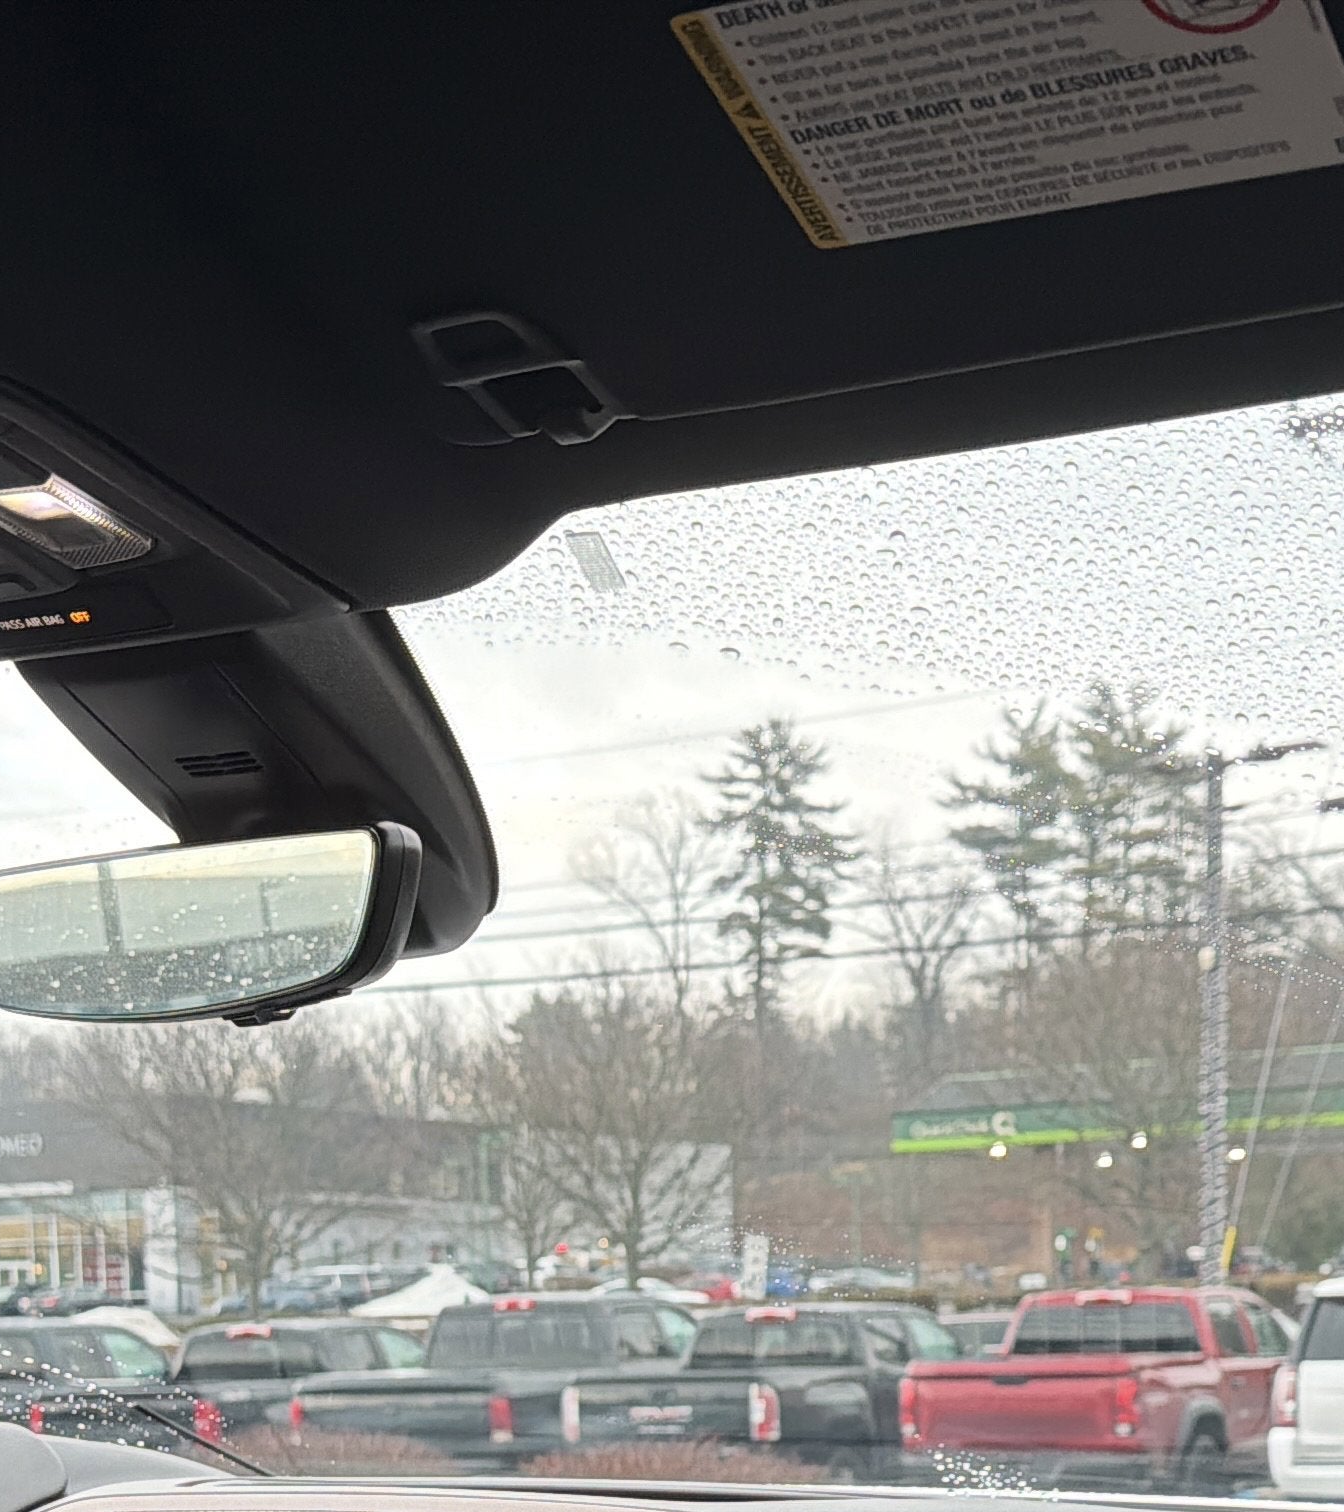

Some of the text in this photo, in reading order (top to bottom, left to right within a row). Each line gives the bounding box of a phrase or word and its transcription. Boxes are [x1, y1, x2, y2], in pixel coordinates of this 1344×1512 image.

[714, 1, 785, 27] DEATH
[788, 117, 872, 143] DANGER
[872, 109, 904, 126] DE
[904, 98, 966, 121] MORT
[969, 95, 997, 108] ou
[998, 87, 1027, 103] de
[1027, 62, 1156, 97] BLESSURES
[25, 617, 42, 629] AIR
[43, 614, 64, 627] BAG
[69, 610, 92, 624] OFF
